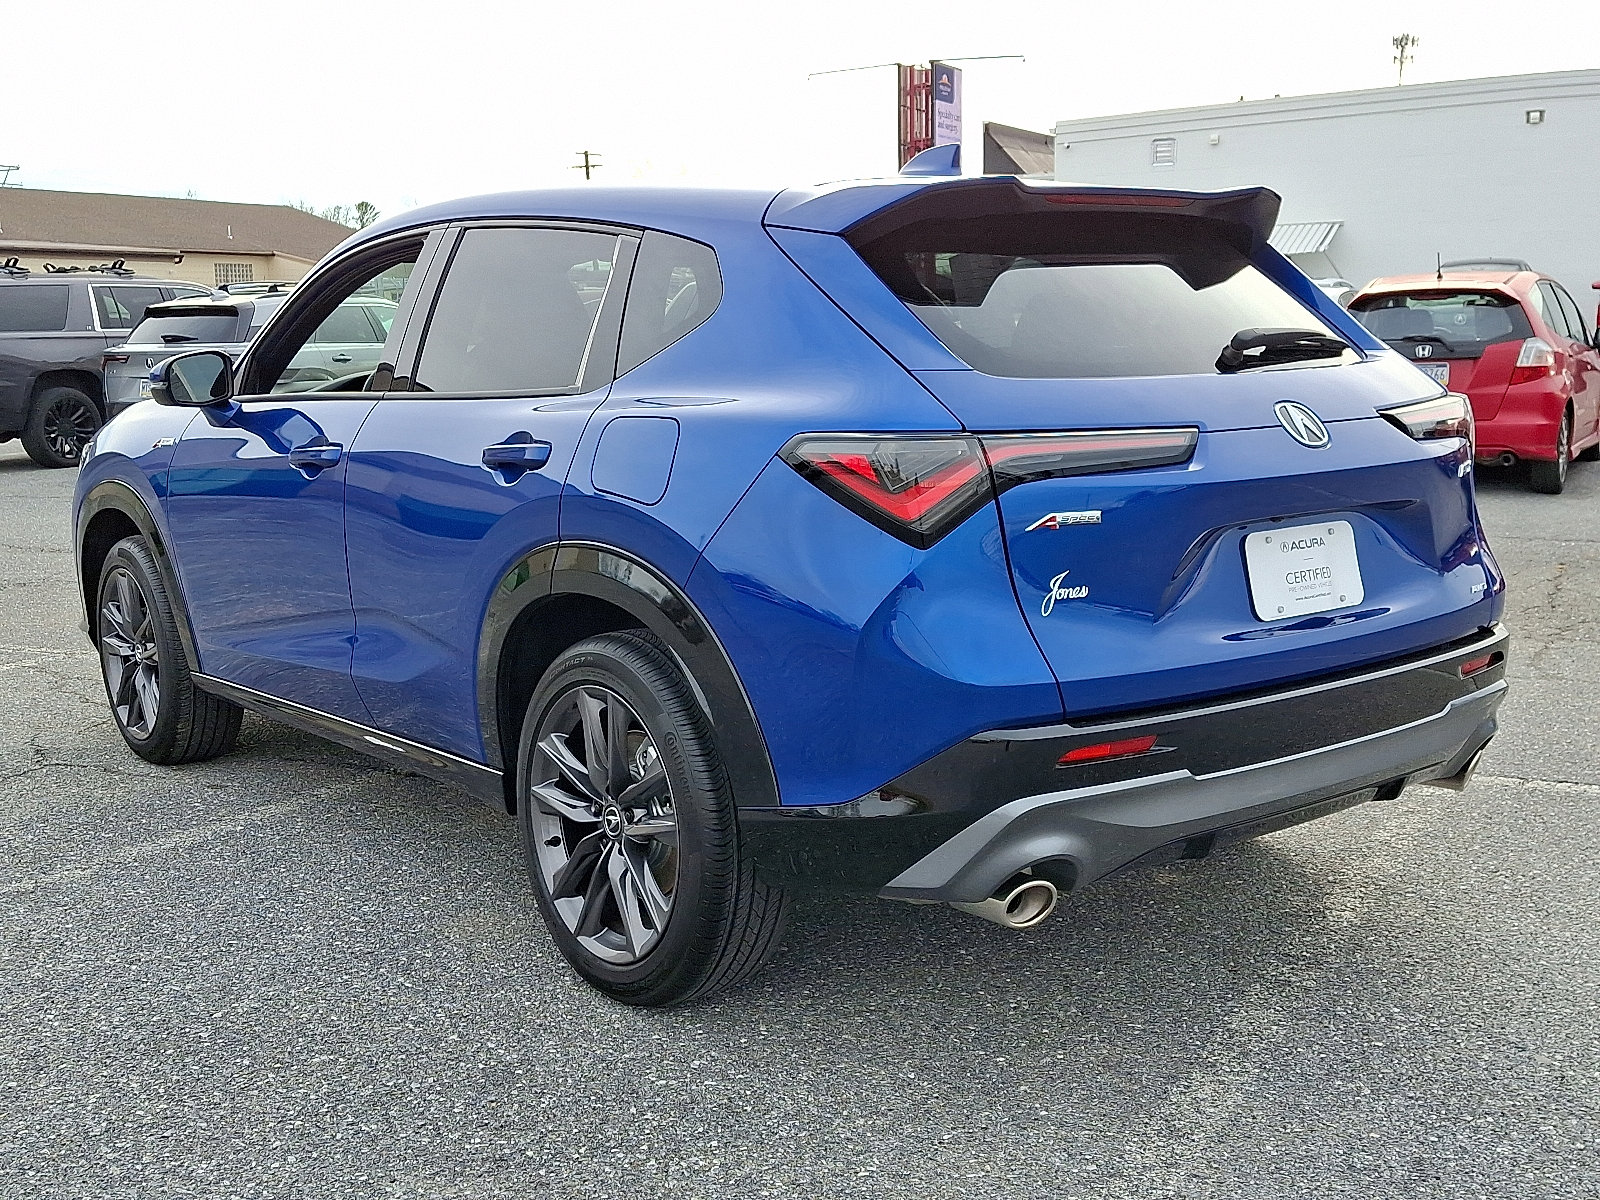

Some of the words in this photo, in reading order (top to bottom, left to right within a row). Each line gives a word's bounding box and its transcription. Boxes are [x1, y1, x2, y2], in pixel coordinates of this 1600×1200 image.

[1290, 537, 1326, 551] ACURA
[1285, 566, 1332, 585] CERTIFIED
[1041, 570, 1089, 617] Jones
